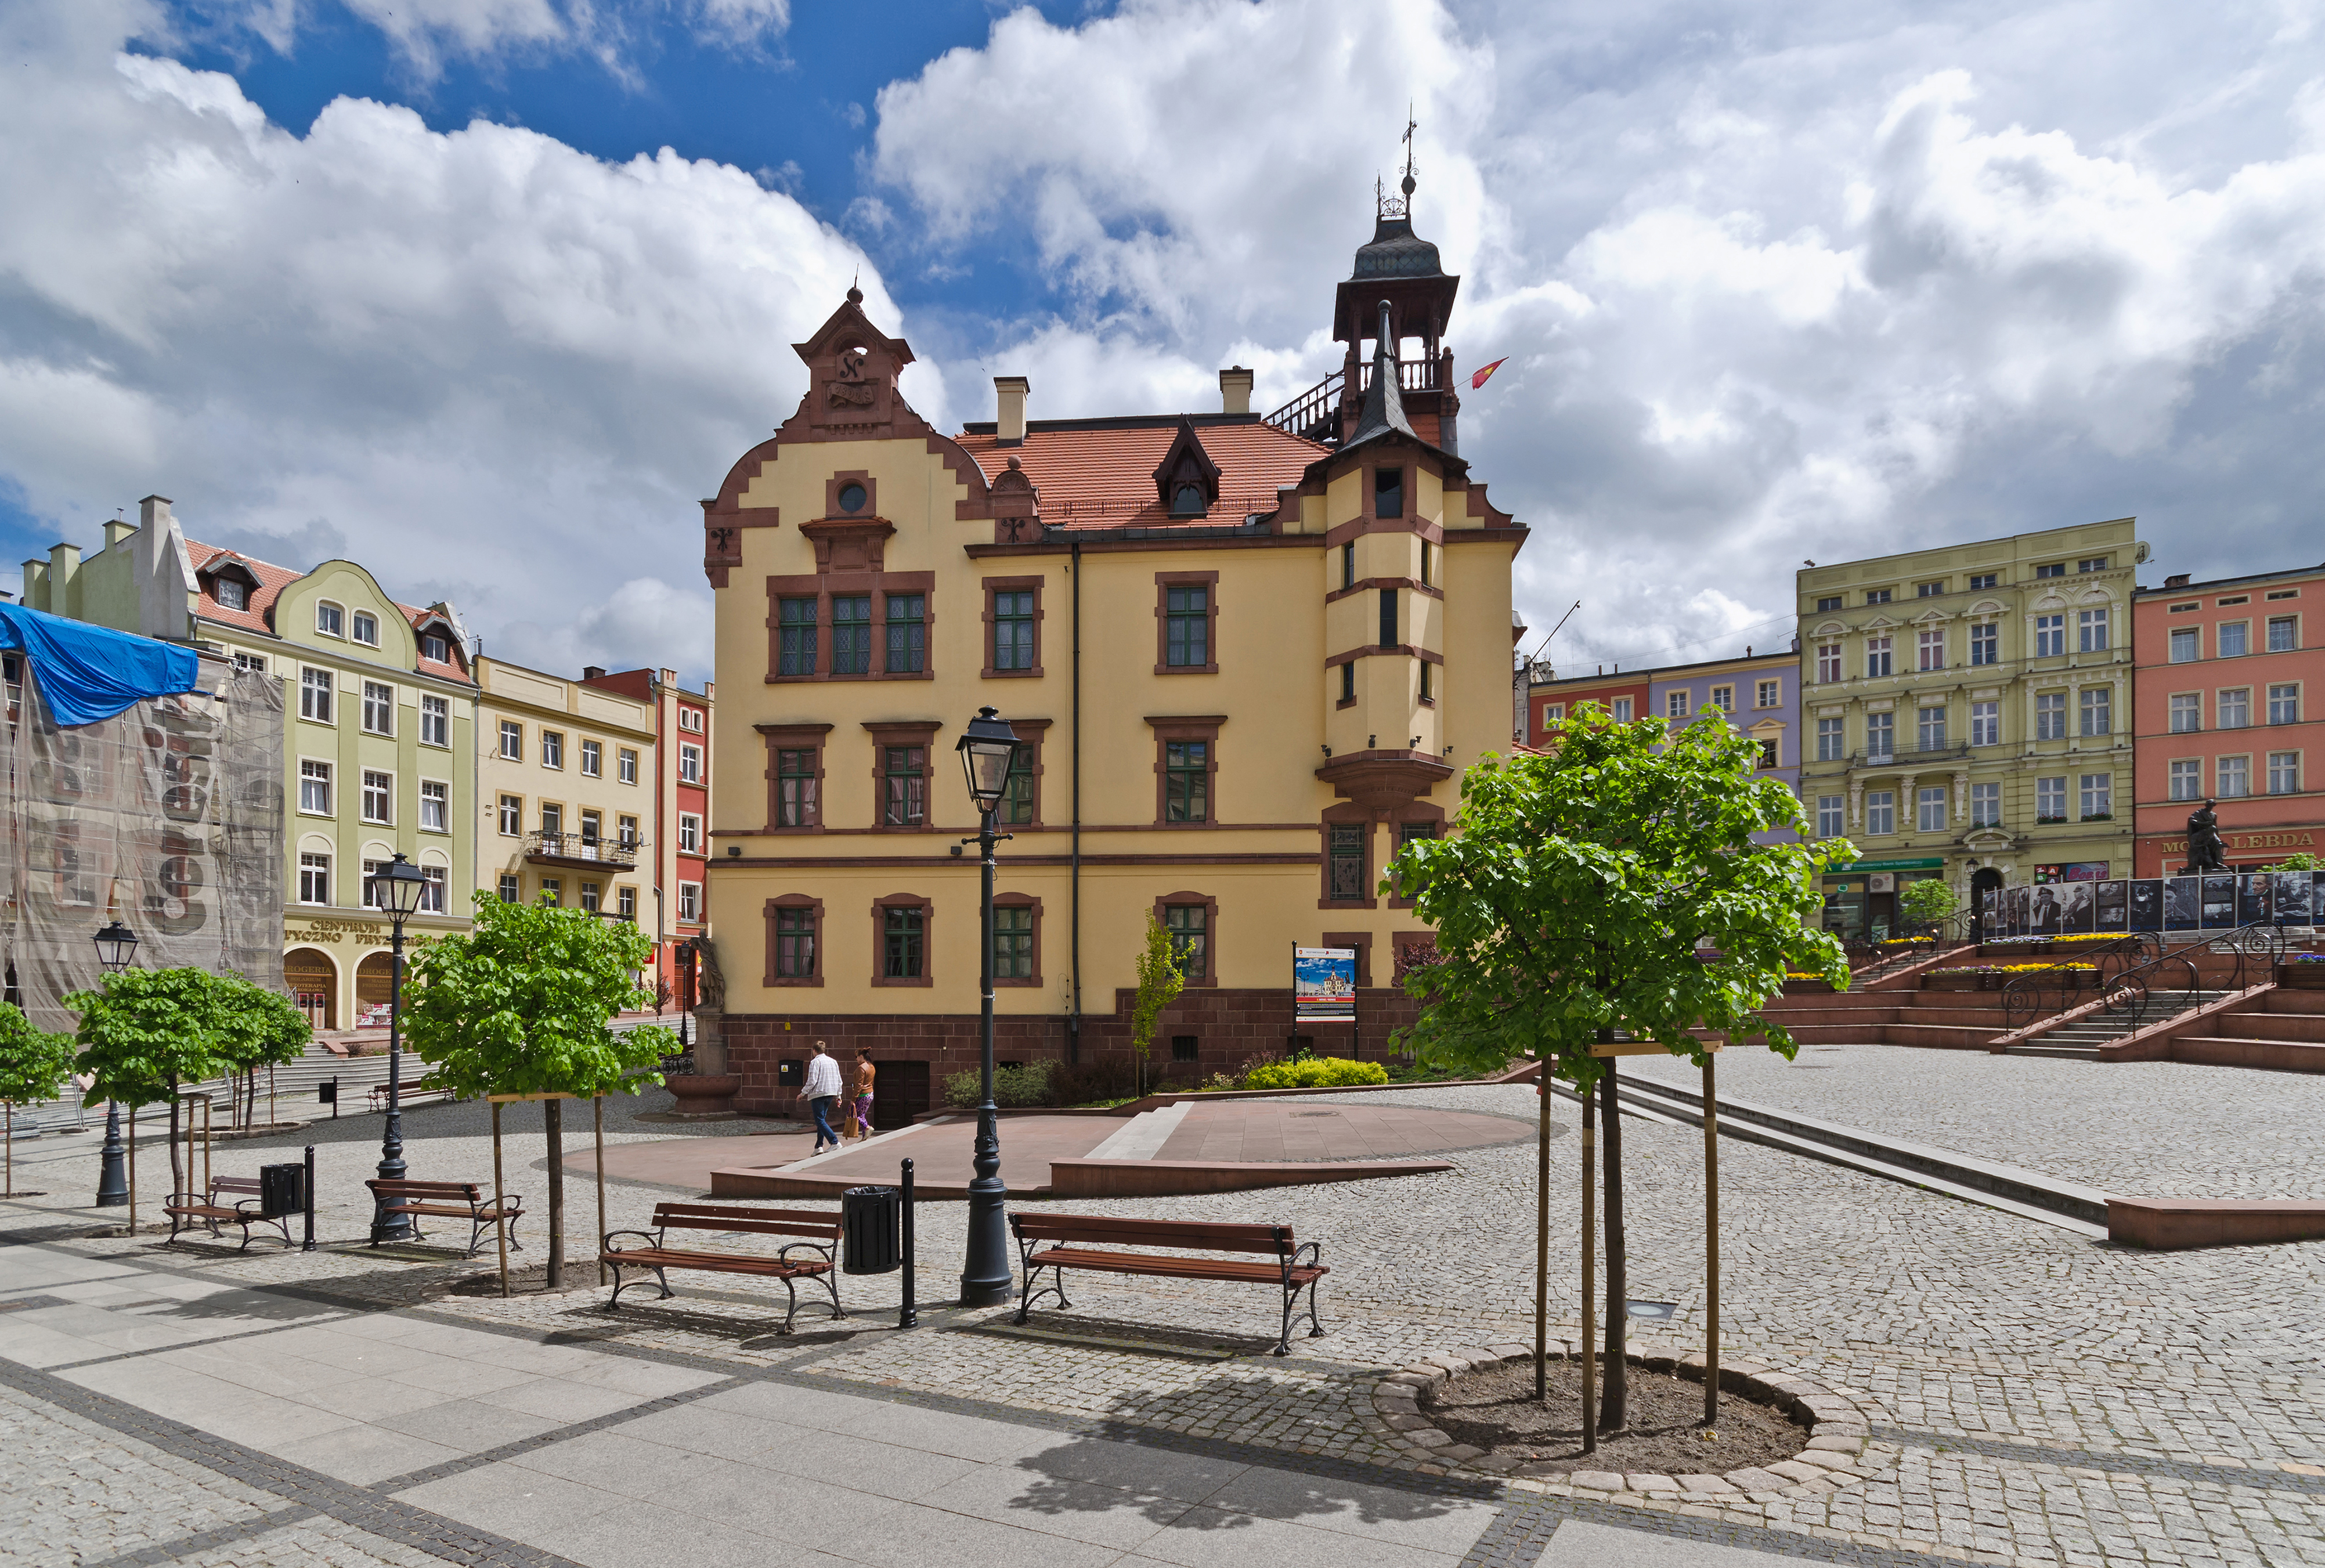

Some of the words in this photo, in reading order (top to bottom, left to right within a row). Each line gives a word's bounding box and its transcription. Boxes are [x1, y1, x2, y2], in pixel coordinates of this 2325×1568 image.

[2161, 841, 2190, 854] MO
[2232, 833, 2316, 850] LEBDA
[310, 919, 381, 934] CENTRUM
[285, 929, 343, 944] TYCZNO
